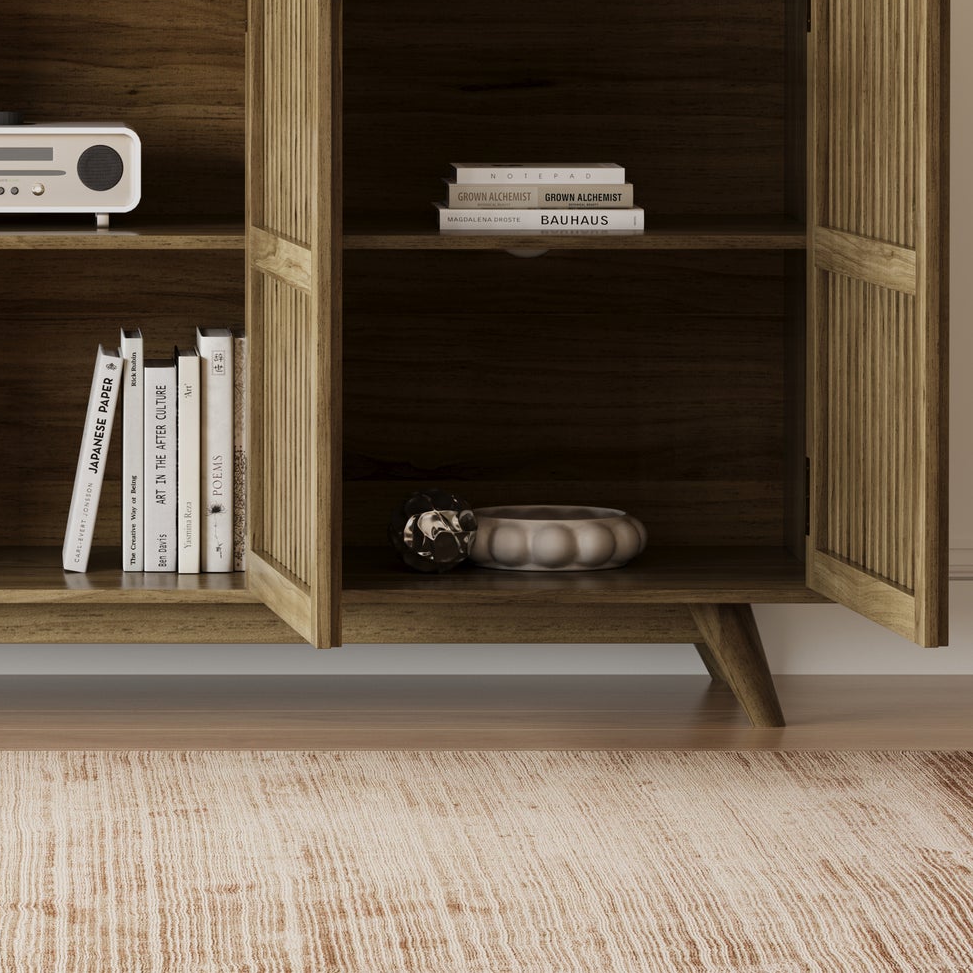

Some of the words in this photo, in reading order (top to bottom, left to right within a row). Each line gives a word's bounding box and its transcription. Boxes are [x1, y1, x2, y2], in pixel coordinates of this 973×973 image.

[458, 192, 487, 202] GROWN
[489, 192, 531, 202] ALCHEMIST
[545, 193, 575, 202] GROWN
[577, 193, 622, 202] ALCHEMIST
[541, 215, 608, 225] BAUHAUS
[156, 385, 166, 420] CULTURE
[88, 418, 106, 474] JAPANESE
[98, 377, 113, 413] PAPER
[156, 425, 166, 450] AFTER
[156, 455, 166, 470] THE
[156, 475, 166, 484] IN
[212, 455, 223, 496] POEMS
[156, 490, 166, 505] ART
[184, 501, 193, 518] Reza
[74, 518, 87, 563] CARL-EVERT
[83, 482, 93, 517] JONSSON
[184, 519, 193, 549] Yasmina
[157, 534, 168, 553] Davis
[158, 556, 167, 567] Ben
